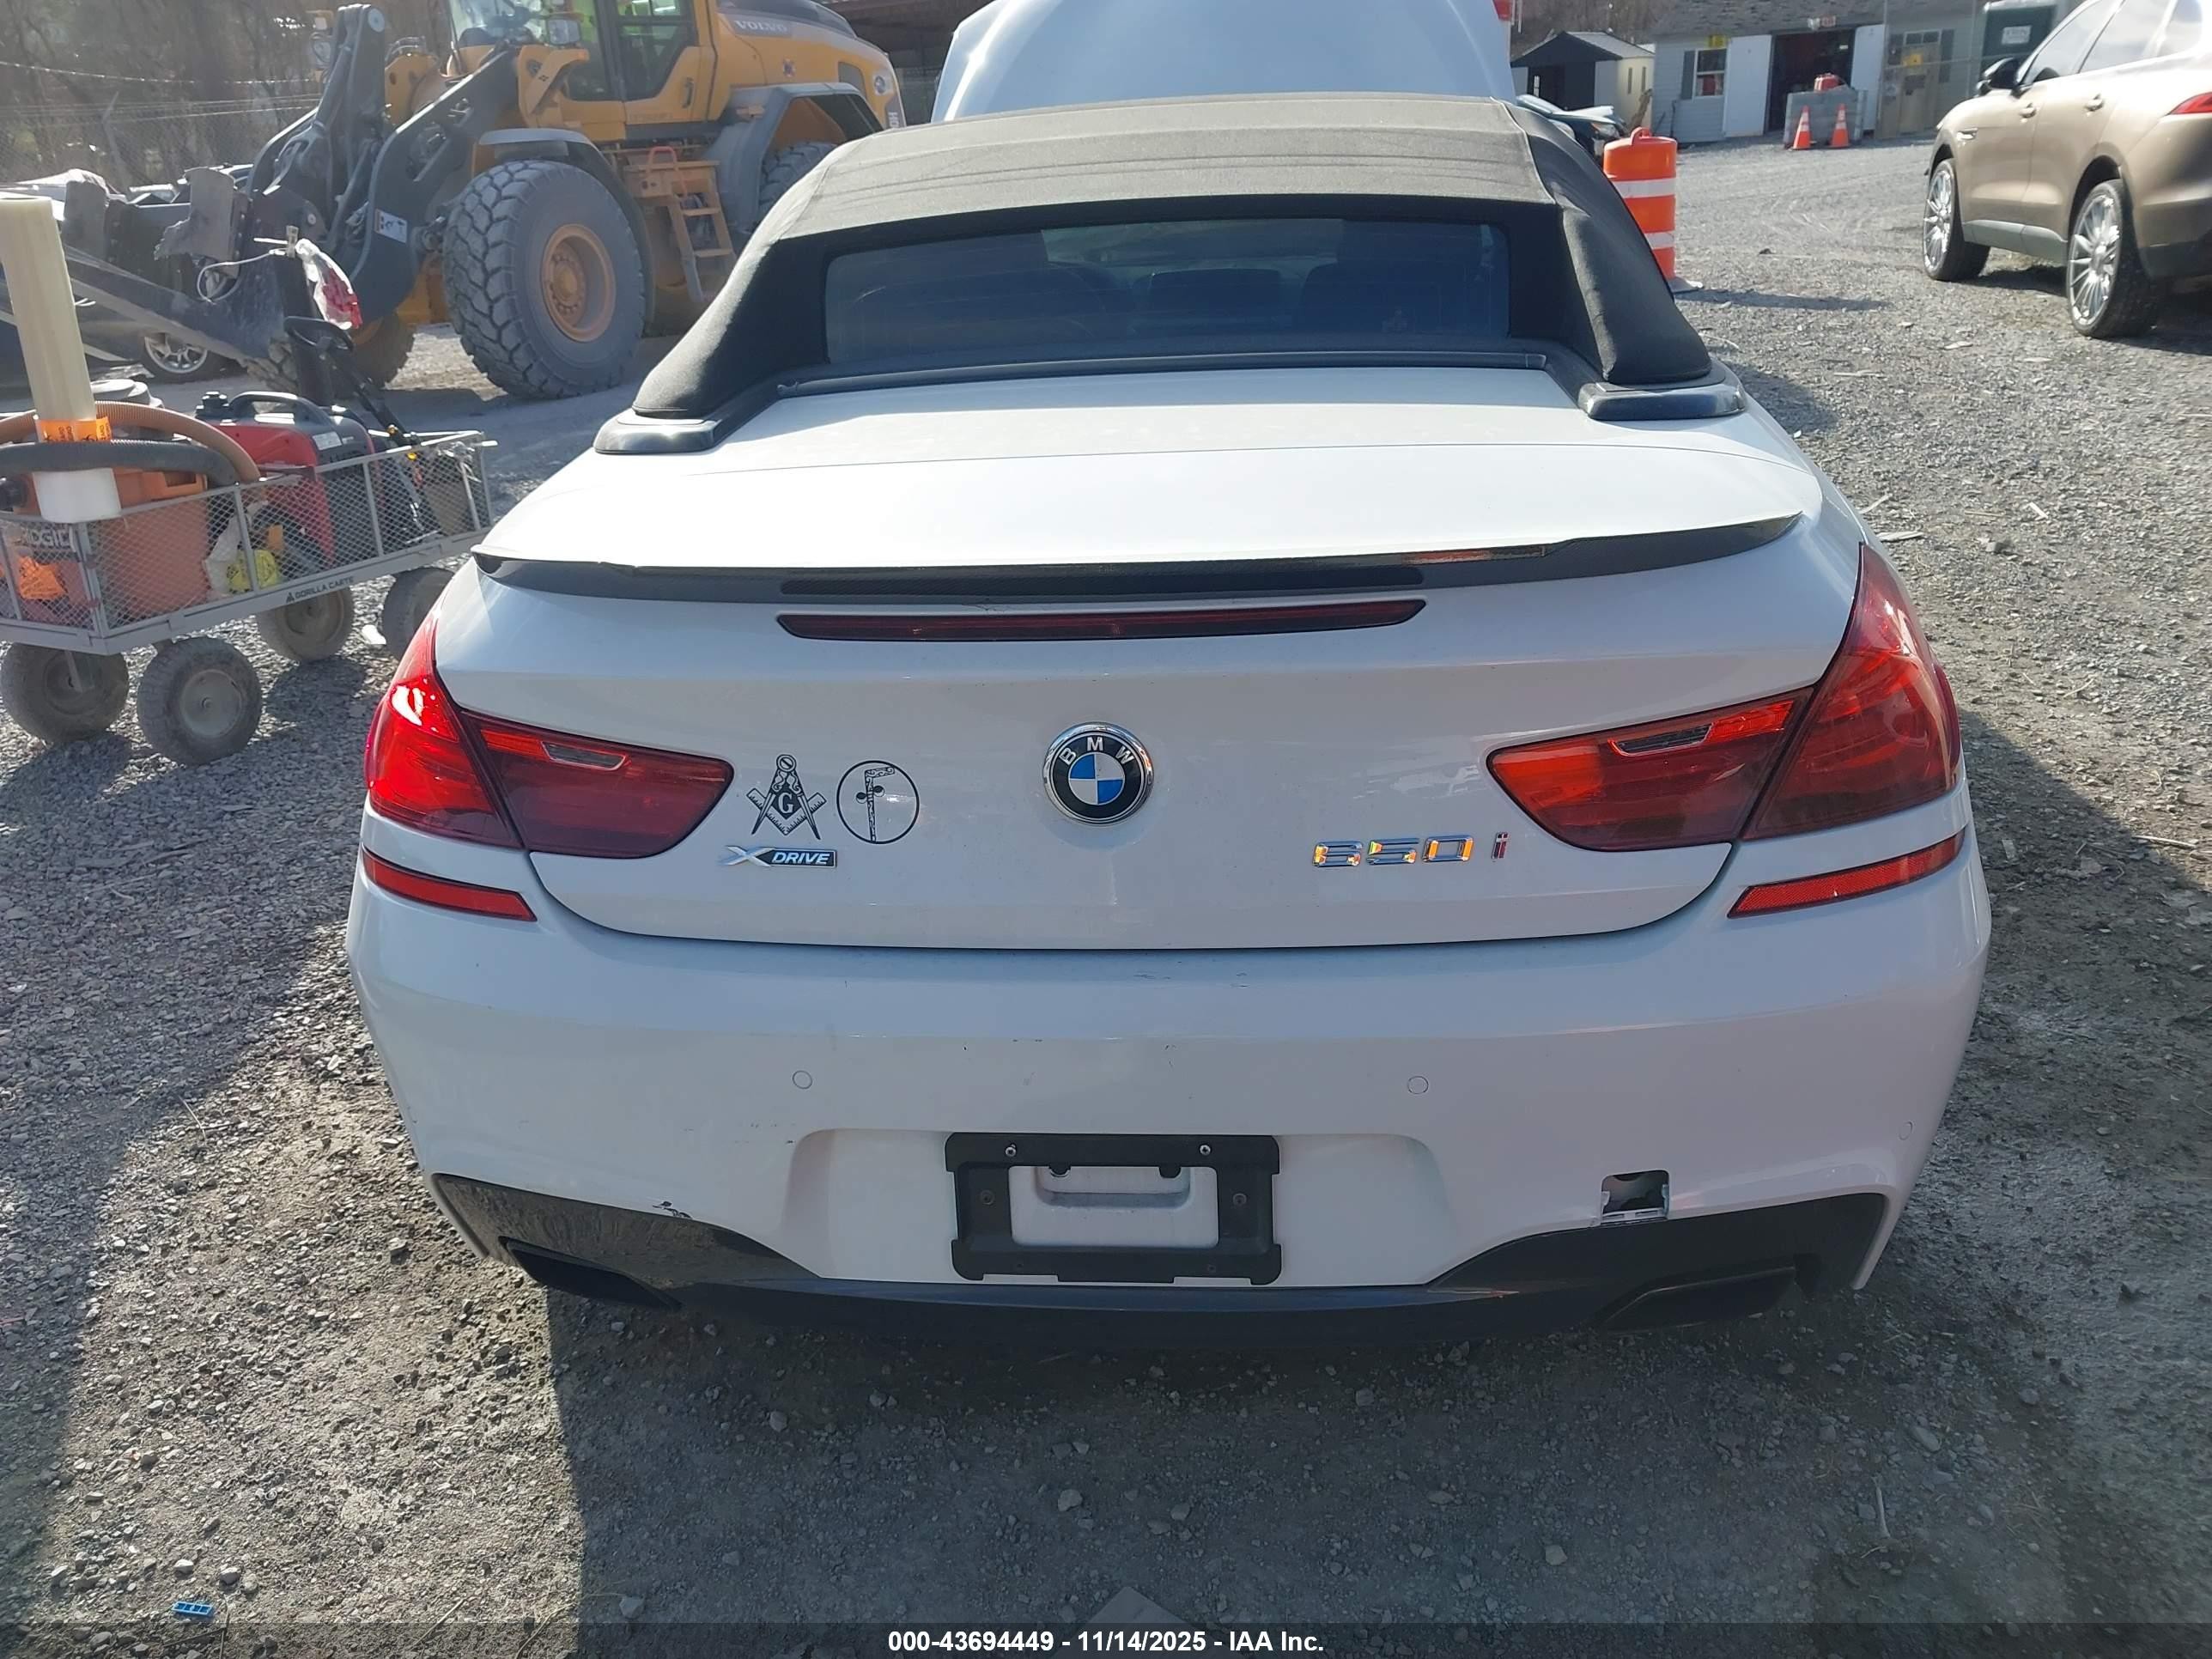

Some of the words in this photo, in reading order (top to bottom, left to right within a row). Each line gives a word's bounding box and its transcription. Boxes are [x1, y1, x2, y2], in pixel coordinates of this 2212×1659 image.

[735, 20, 788, 33] VOLVO
[1059, 737, 1134, 766] BMW
[778, 792, 793, 814] G
